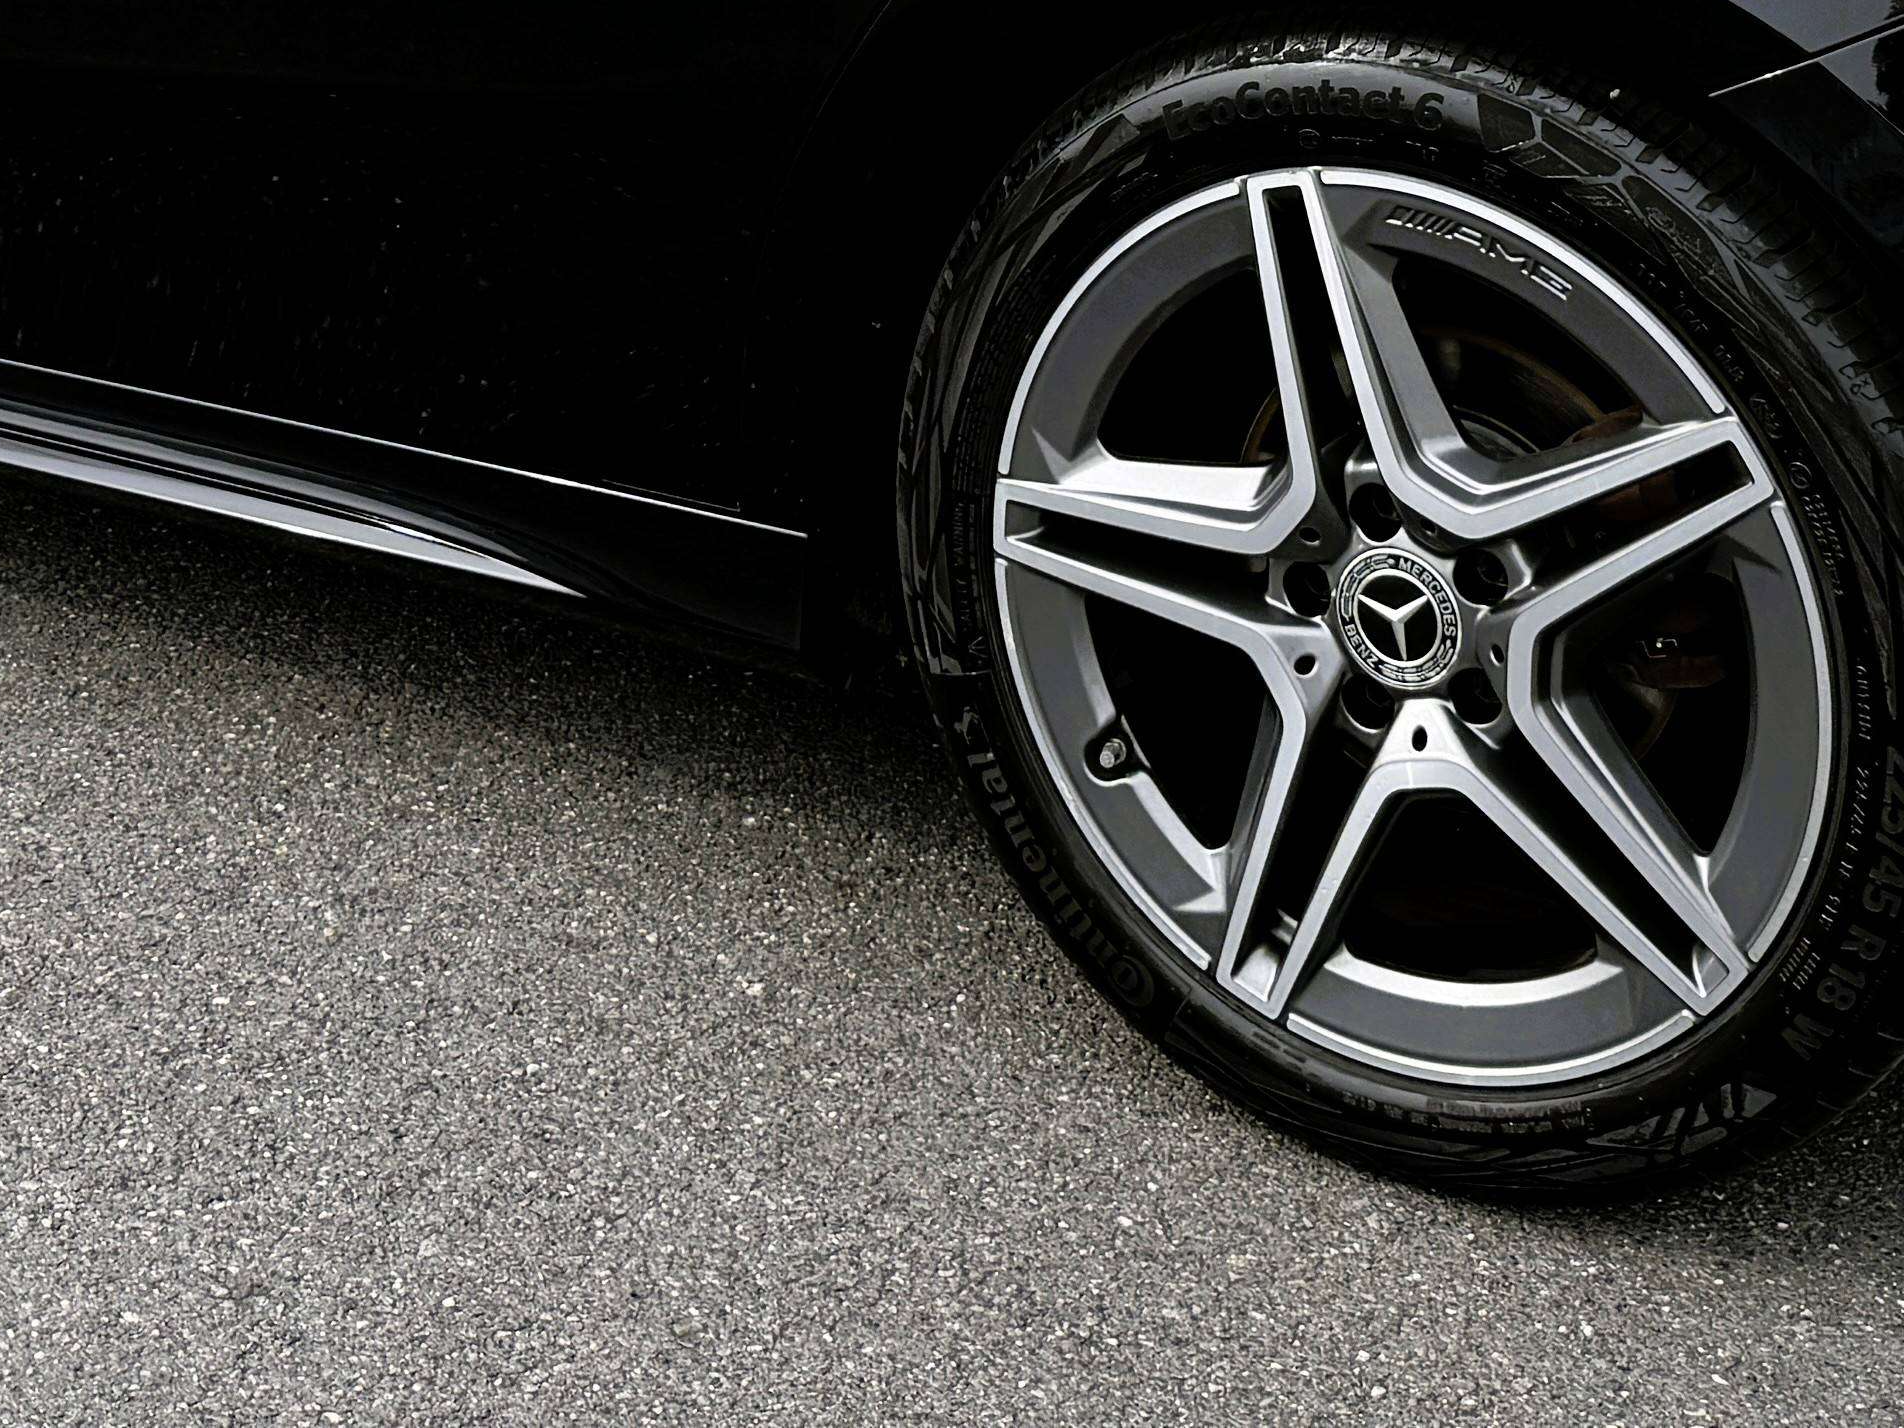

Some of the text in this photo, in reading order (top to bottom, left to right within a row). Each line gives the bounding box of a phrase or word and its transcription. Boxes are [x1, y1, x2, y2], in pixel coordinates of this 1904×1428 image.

[1162, 78, 1445, 141] EcoContact 6
[1398, 556, 1457, 638] MERCEDES
[1344, 623, 1381, 669] BENZ
[1840, 924, 1888, 961] R
[1817, 962, 1866, 1011] 18
